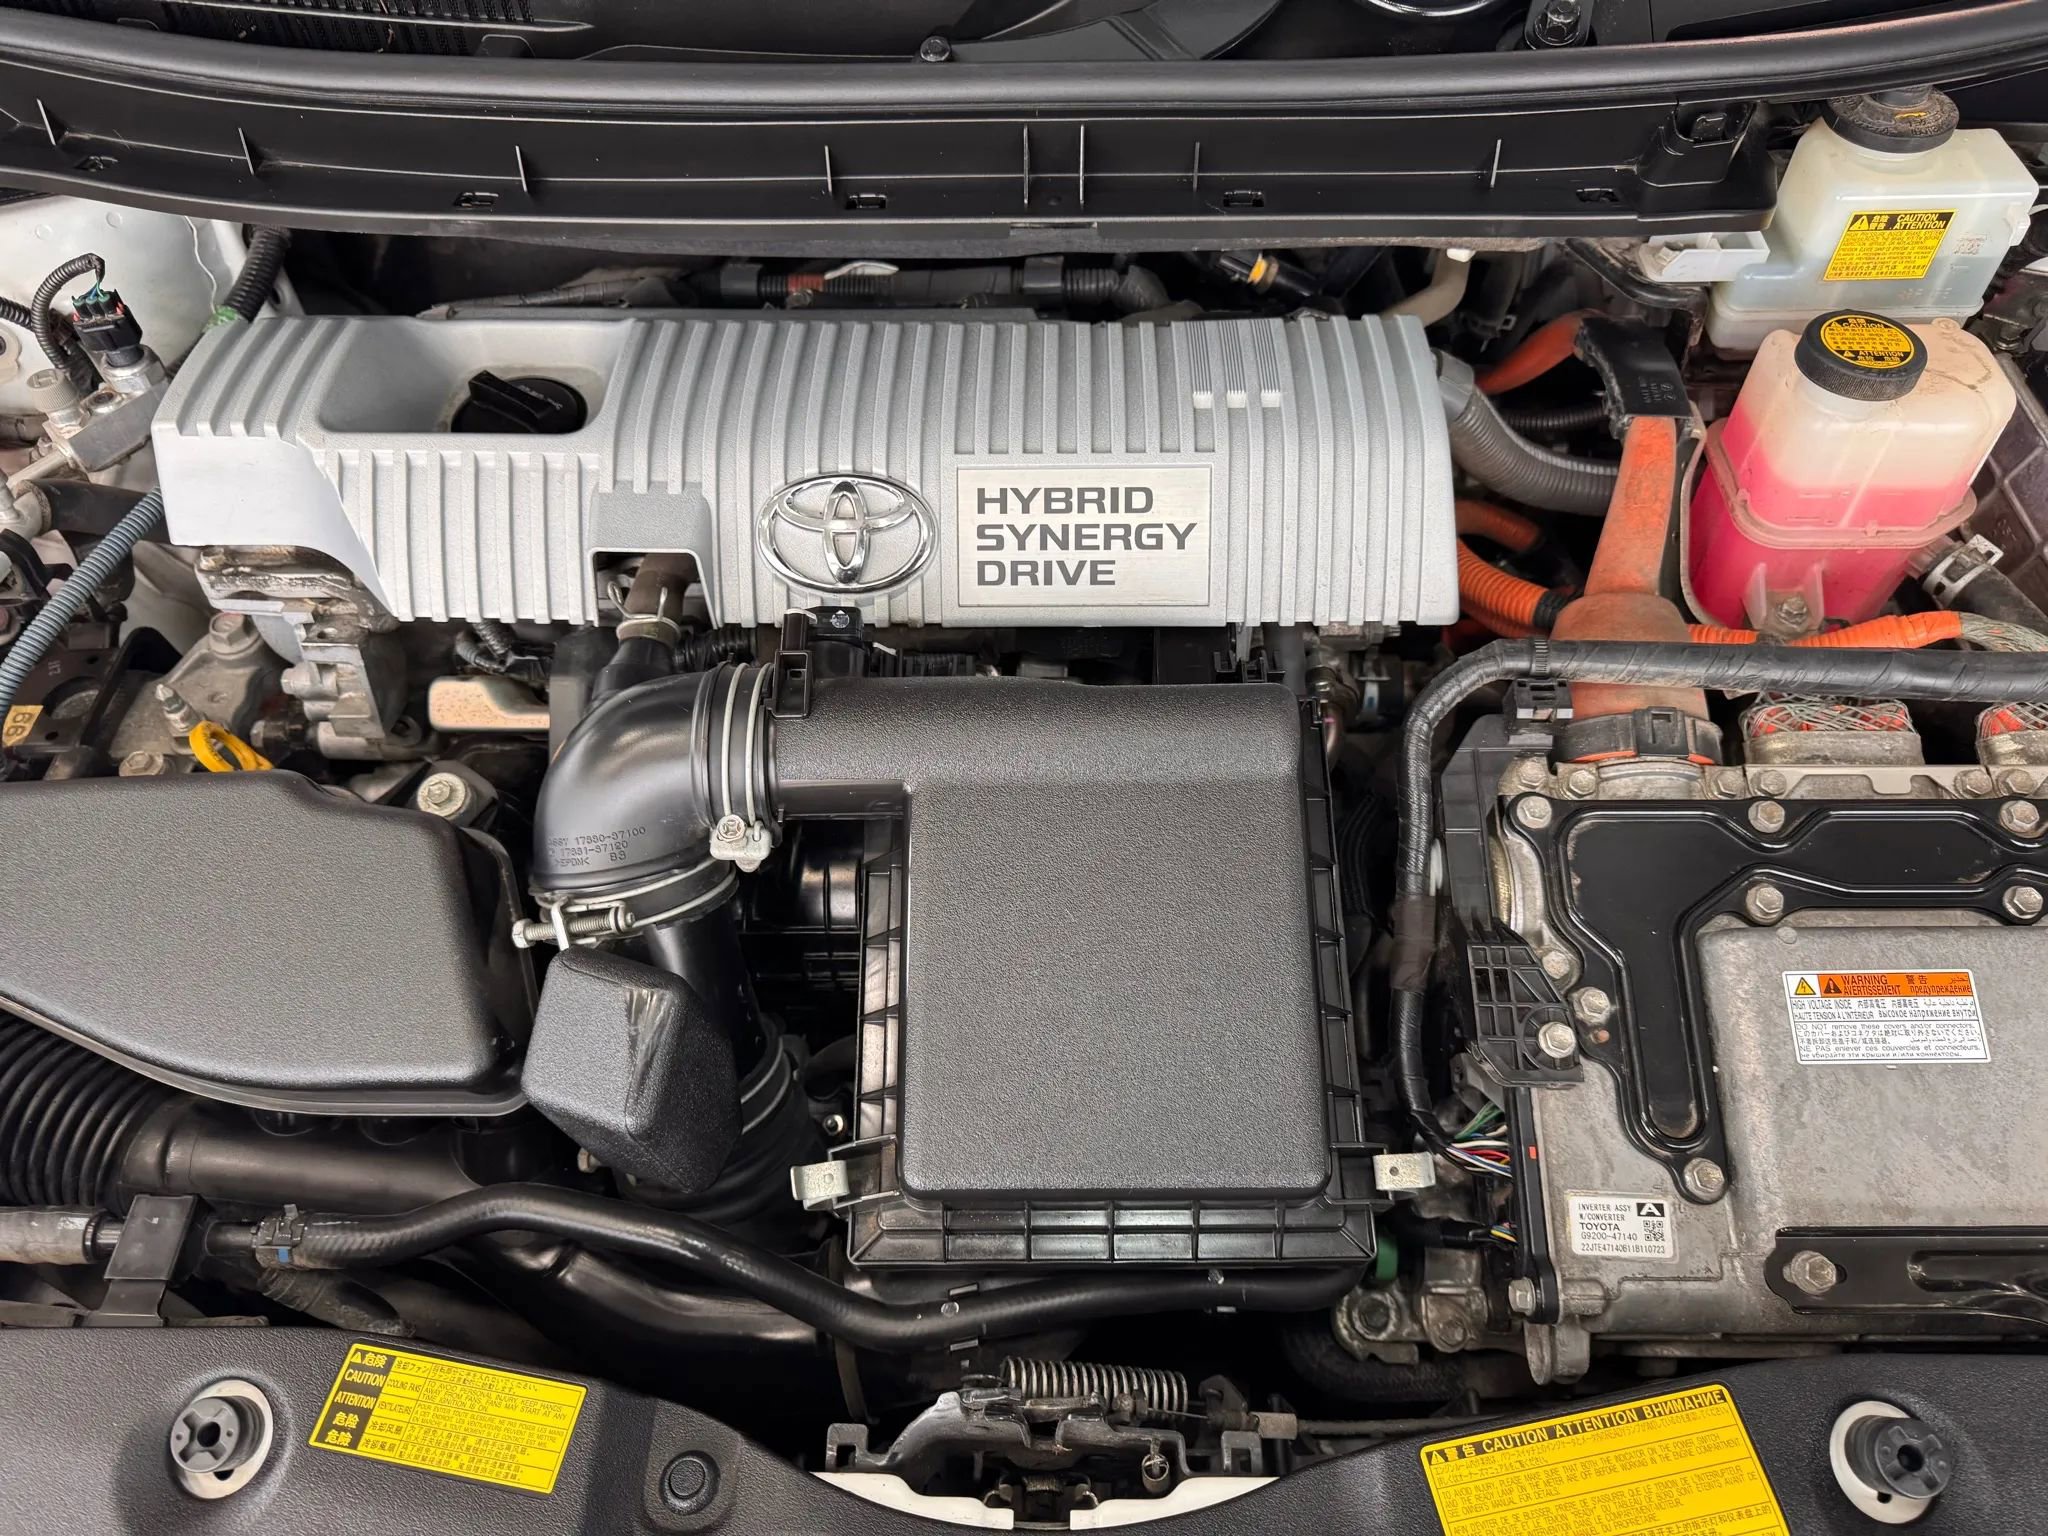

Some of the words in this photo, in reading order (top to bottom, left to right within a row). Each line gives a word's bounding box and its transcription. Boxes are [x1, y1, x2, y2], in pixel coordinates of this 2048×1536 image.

[1893, 221, 1946, 230] ATTENTION
[1897, 214, 1938, 222] CAUTION
[977, 487, 1153, 514] HYBRID
[977, 523, 1198, 551] SYNERGY
[977, 560, 1116, 586] DRIVE
[1841, 975, 1887, 985] WARNING
[1905, 974, 1927, 984] 警告
[1843, 984, 1900, 994] AVERTISSEMENT
[1910, 985, 1970, 995] предупреждение
[1791, 999, 1805, 1009] HIGH
[1808, 999, 1832, 1009] VOLTAGE
[1834, 999, 1851, 1008] INSIDE
[1579, 1203, 1610, 1211] INVERTER
[1580, 1213, 1625, 1221] W/CONVERTER
[1580, 1222, 1620, 1231] TOYOTA
[1581, 1232, 1638, 1240] G9200-47140
[345, 1369, 385, 1386] CAUTION
[386, 1378, 408, 1389] COOLING
[408, 1382, 421, 1392] FANS
[334, 1391, 375, 1408] ATTENTION
[422, 1393, 437, 1402] TIME
[438, 1397, 467, 1407] IGNITION
[423, 1387, 442, 1395] AWAY
[443, 1391, 463, 1399] FROM
[484, 1399, 502, 1408] FANS
[519, 1406, 540, 1415] START
[553, 1412, 567, 1420] ANY
[427, 1380, 436, 1388] TO
[437, 1383, 457, 1392] AVOID
[459, 1387, 491, 1398] PERSONAL
[520, 1399, 538, 1407] KEEP
[539, 1403, 561, 1412] HANDS
[377, 1400, 412, 1414] VENTILATEURS
[1643, 1391, 1722, 1417] ВНИМАНИЕ
[1556, 1409, 1637, 1436] ATTENTION
[1482, 1428, 1547, 1452] CAUTION
[1441, 1490, 1451, 1499] TO
[1453, 1486, 1471, 1497] AVOID
[1498, 1475, 1522, 1487] PLEASE
[1523, 1471, 1541, 1481] MAKE
[1543, 1467, 1560, 1478] SURE
[1562, 1463, 1578, 1473] THAT
[1579, 1459, 1597, 1470] BOTH
[1599, 1456, 1612, 1465] THE
[1614, 1449, 1645, 1462] INDICATOR
[1646, 1447, 1657, 1456] ON
[1657, 1443, 1672, 1452] THE
[1672, 1438, 1695, 1449] POWER
[1696, 1433, 1720, 1444] SWITCH
[1445, 1499, 1458, 1508] AND
[1460, 1495, 1472, 1504] THE
[1474, 1491, 1494, 1502] READY
[1496, 1486, 1513, 1497] LAMP
[1516, 1484, 1527, 1493] ON
[1528, 1481, 1541, 1489] THE
[1542, 1476, 1564, 1487] METER
[1566, 1472, 1579, 1482] ARE
[1579, 1469, 1592, 1479] OFF
[1594, 1464, 1618, 1476] BEFORE
[1620, 1458, 1648, 1470] WORKING
[1658, 1452, 1672, 1462] THE
[1672, 1448, 1694, 1459] ENGINE
[1499, 1515, 1510, 1525] DE
[1511, 1512, 1521, 1522] SE
[1578, 1498, 1589, 1508] DE
[1627, 1486, 1642, 1497] QUE
[1642, 1484, 1653, 1494] LE
[1679, 1476, 1689, 1486] DE
[1691, 1465, 1742, 1483] L'INTERRUPTEUR
[1447, 1507, 1460, 1518] SEE
[1461, 1501, 1489, 1514] OWNER'S
[1490, 1496, 1516, 1508] MANUAL
[1518, 1492, 1532, 1502] FOR
